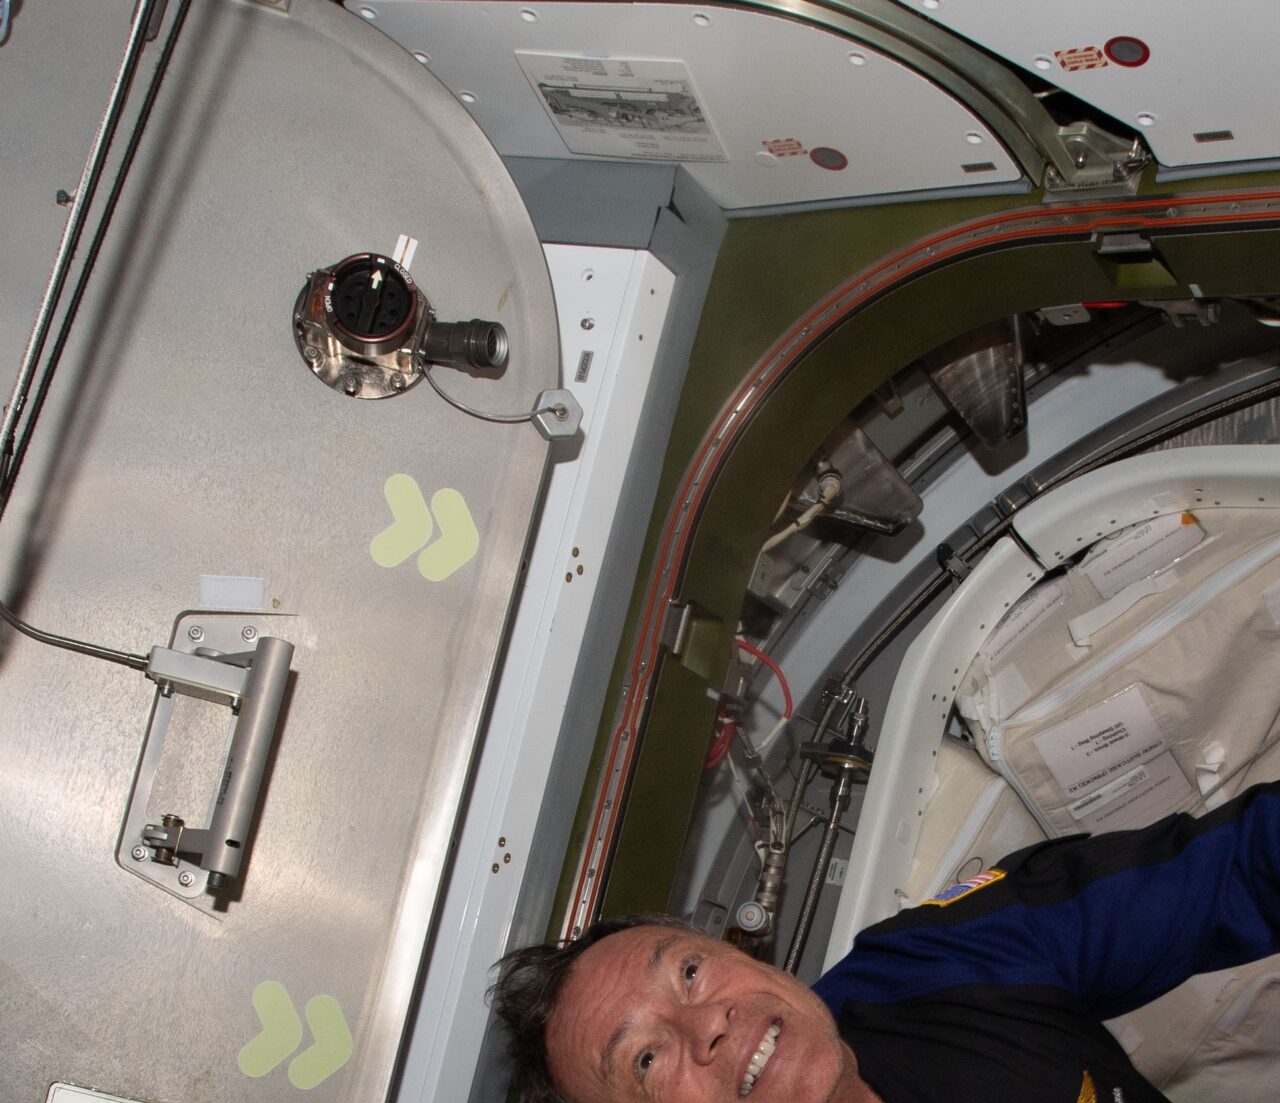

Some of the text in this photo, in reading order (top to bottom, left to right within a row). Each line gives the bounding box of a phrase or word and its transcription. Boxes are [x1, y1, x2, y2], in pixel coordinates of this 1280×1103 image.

[394, 263, 412, 283] CLOSED
[1102, 727, 1126, 741] Clothing
[1142, 741, 1162, 754] CREW
[1108, 752, 1141, 772] SUITCASE
[1078, 771, 1107, 788] (FINCKE)
